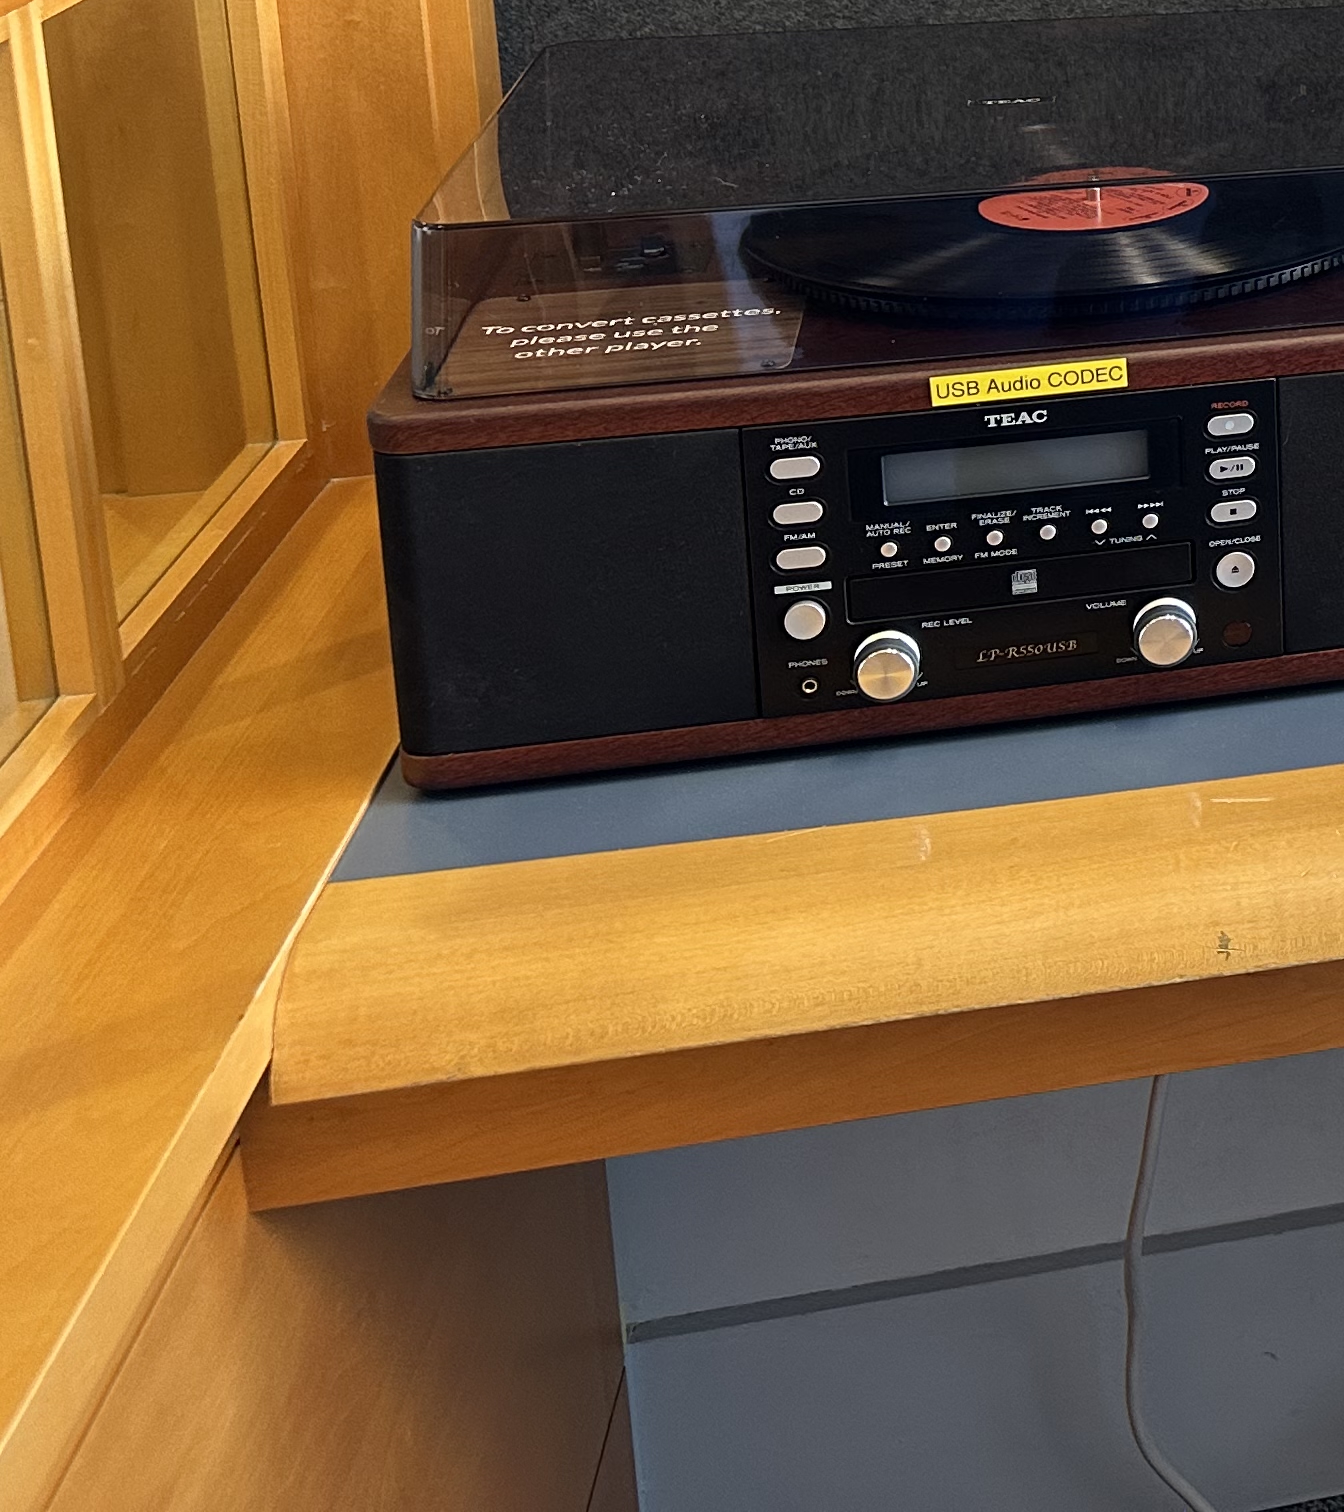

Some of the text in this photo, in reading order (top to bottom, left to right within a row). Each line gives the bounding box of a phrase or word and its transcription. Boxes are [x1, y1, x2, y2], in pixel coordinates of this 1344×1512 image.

[481, 325, 517, 336] To
[521, 316, 635, 334] convert
[509, 322, 719, 348] please use the
[514, 337, 701, 359] other player.
[936, 365, 1124, 399] USB Audio CODEC
[1210, 400, 1249, 409] RECORD
[984, 409, 1048, 428] TEAC
[774, 436, 812, 444] PHONO/
[770, 441, 818, 452] TAPE/AUX
[1204, 443, 1260, 455] PLAY/PAUSE
[789, 488, 805, 496] CD
[1222, 487, 1246, 497] STOP
[1030, 505, 1063, 513] TRACK
[971, 510, 1017, 520] FINALIZE/
[1022, 510, 1071, 521] INCREMENT
[865, 521, 911, 531] MANUAL/
[926, 522, 957, 532] ENTER
[978, 517, 1011, 526] ERASE
[893, 527, 912, 535] REC
[783, 532, 816, 542] FM/AM
[1109, 535, 1143, 544] TUNING
[1208, 535, 1261, 547] OPEN/CLOSE
[990, 549, 1018, 557] MODE
[872, 559, 909, 570] PRESET
[922, 554, 964, 565] MEMORY
[785, 583, 820, 592] POWER
[1085, 599, 1127, 611] VOLUME
[921, 618, 973, 629] REC LEVEL
[975, 639, 1078, 663] LP-R550USB
[788, 658, 828, 669] PHONES
